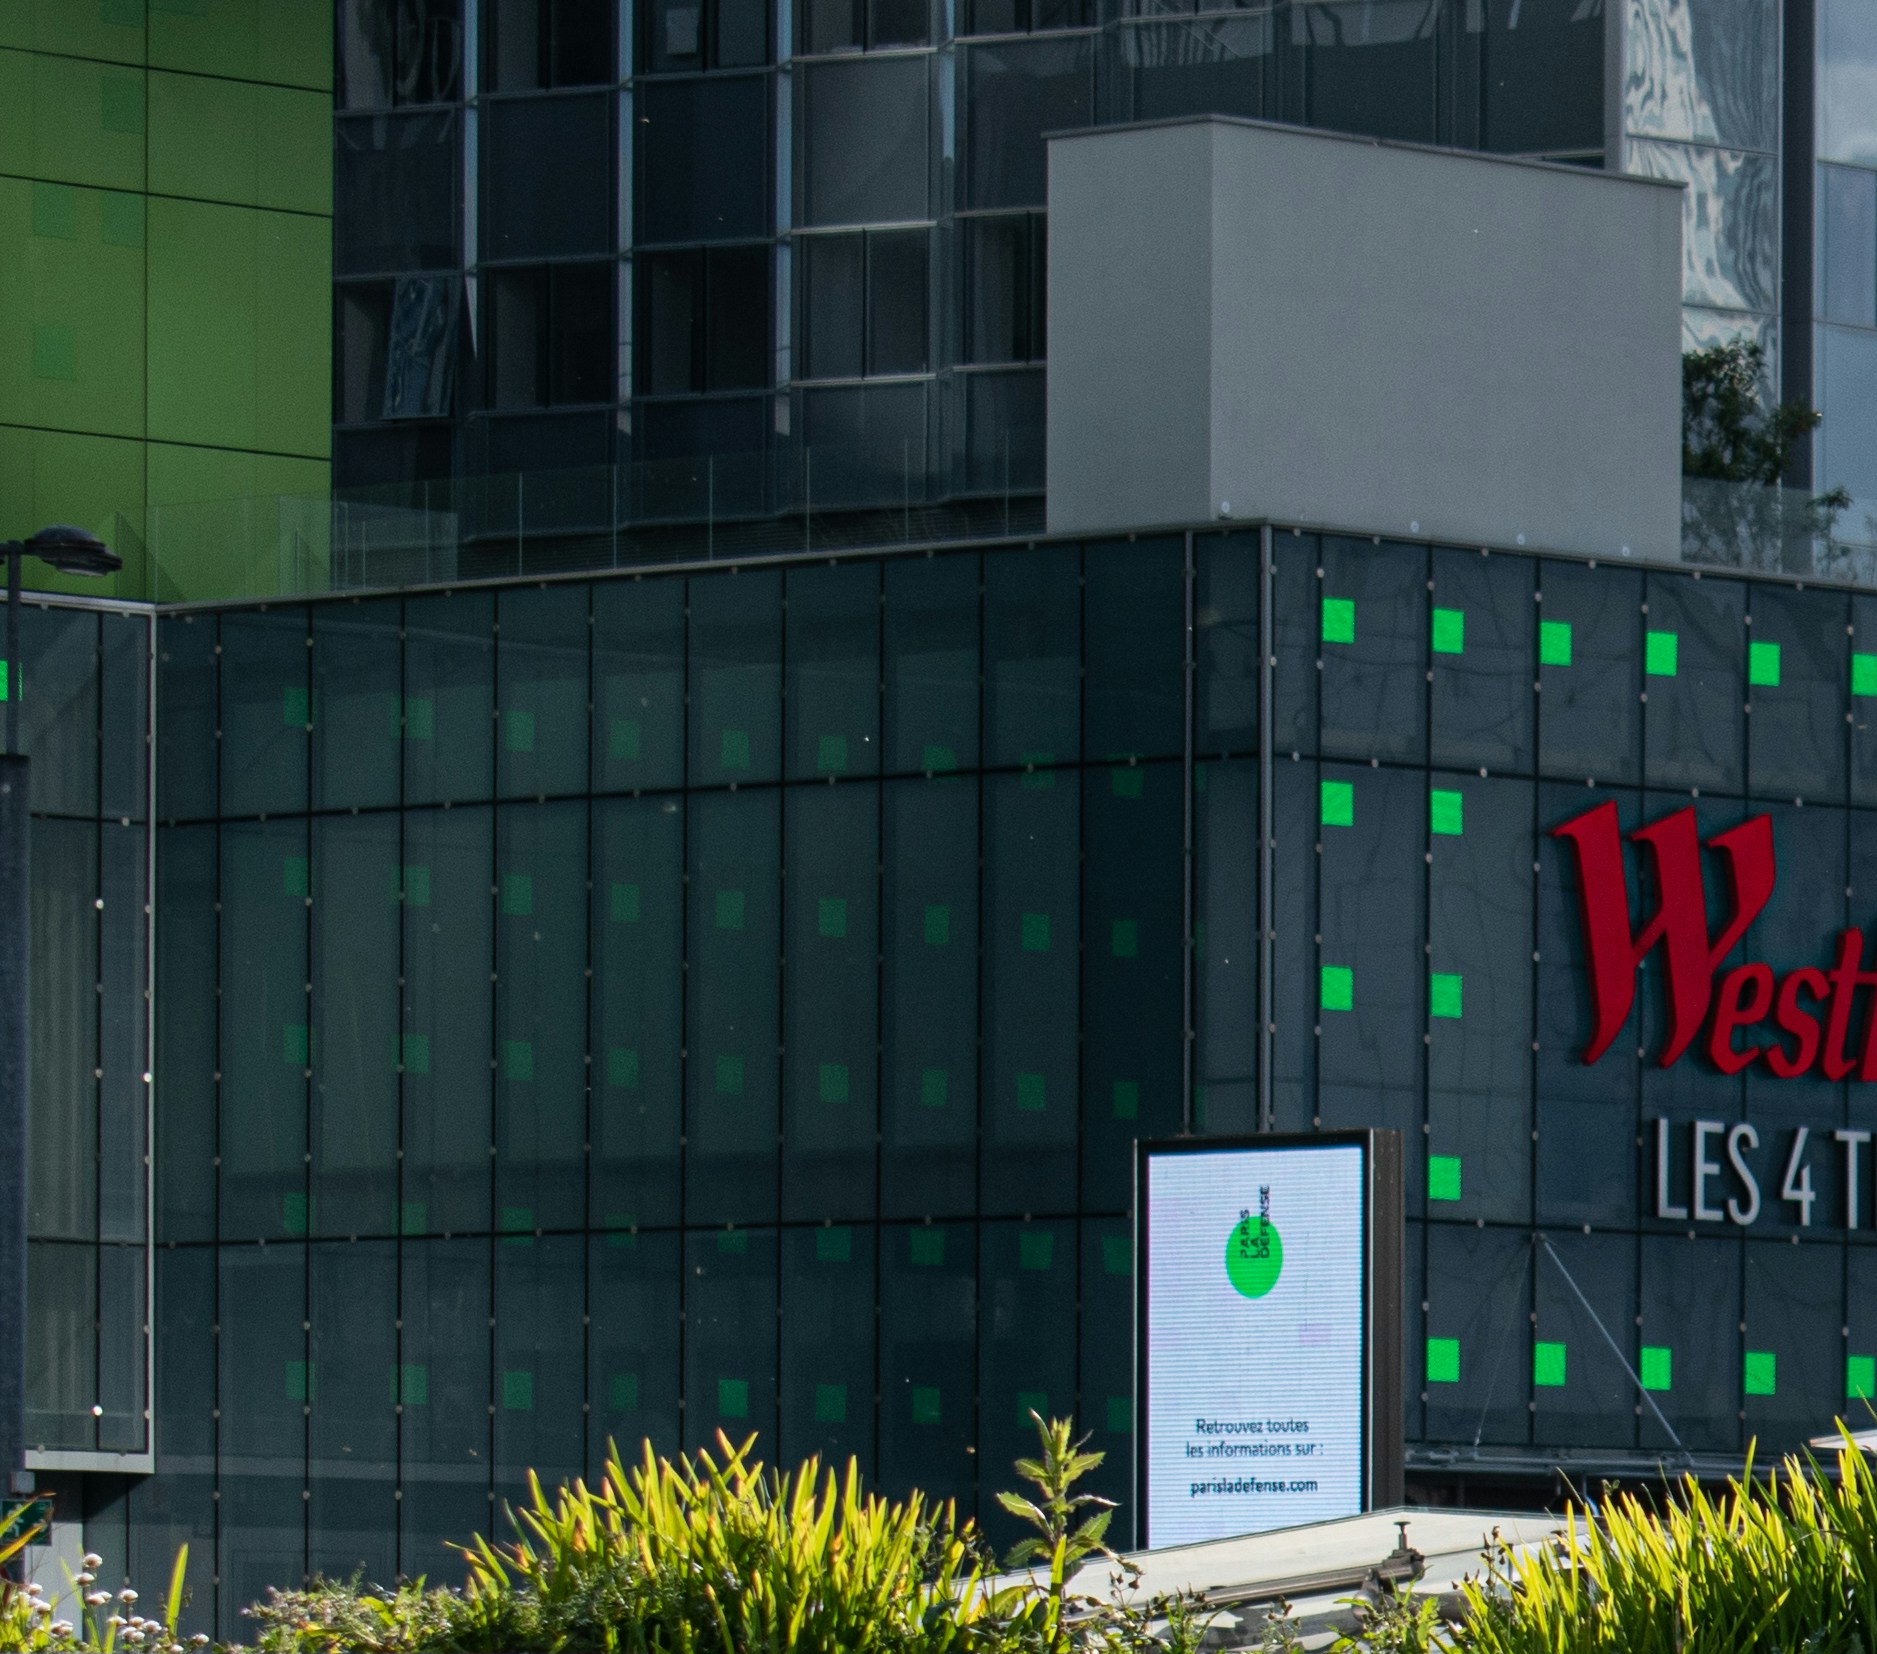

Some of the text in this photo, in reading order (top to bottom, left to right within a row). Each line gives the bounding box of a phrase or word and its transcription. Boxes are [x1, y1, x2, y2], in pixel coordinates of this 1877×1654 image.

[1655, 1118, 1761, 1226] LES
[1781, 1127, 1816, 1227] 4
[1240, 1209, 1250, 1259] PARIS
[1250, 1237, 1260, 1259] LA
[1196, 1416, 1310, 1434] Retrouvez toutes
[1186, 1440, 1203, 1457] les
[1208, 1438, 1291, 1457] informations
[1295, 1442, 1316, 1456] sur
[1190, 1477, 1318, 1498] parisladefense.com
